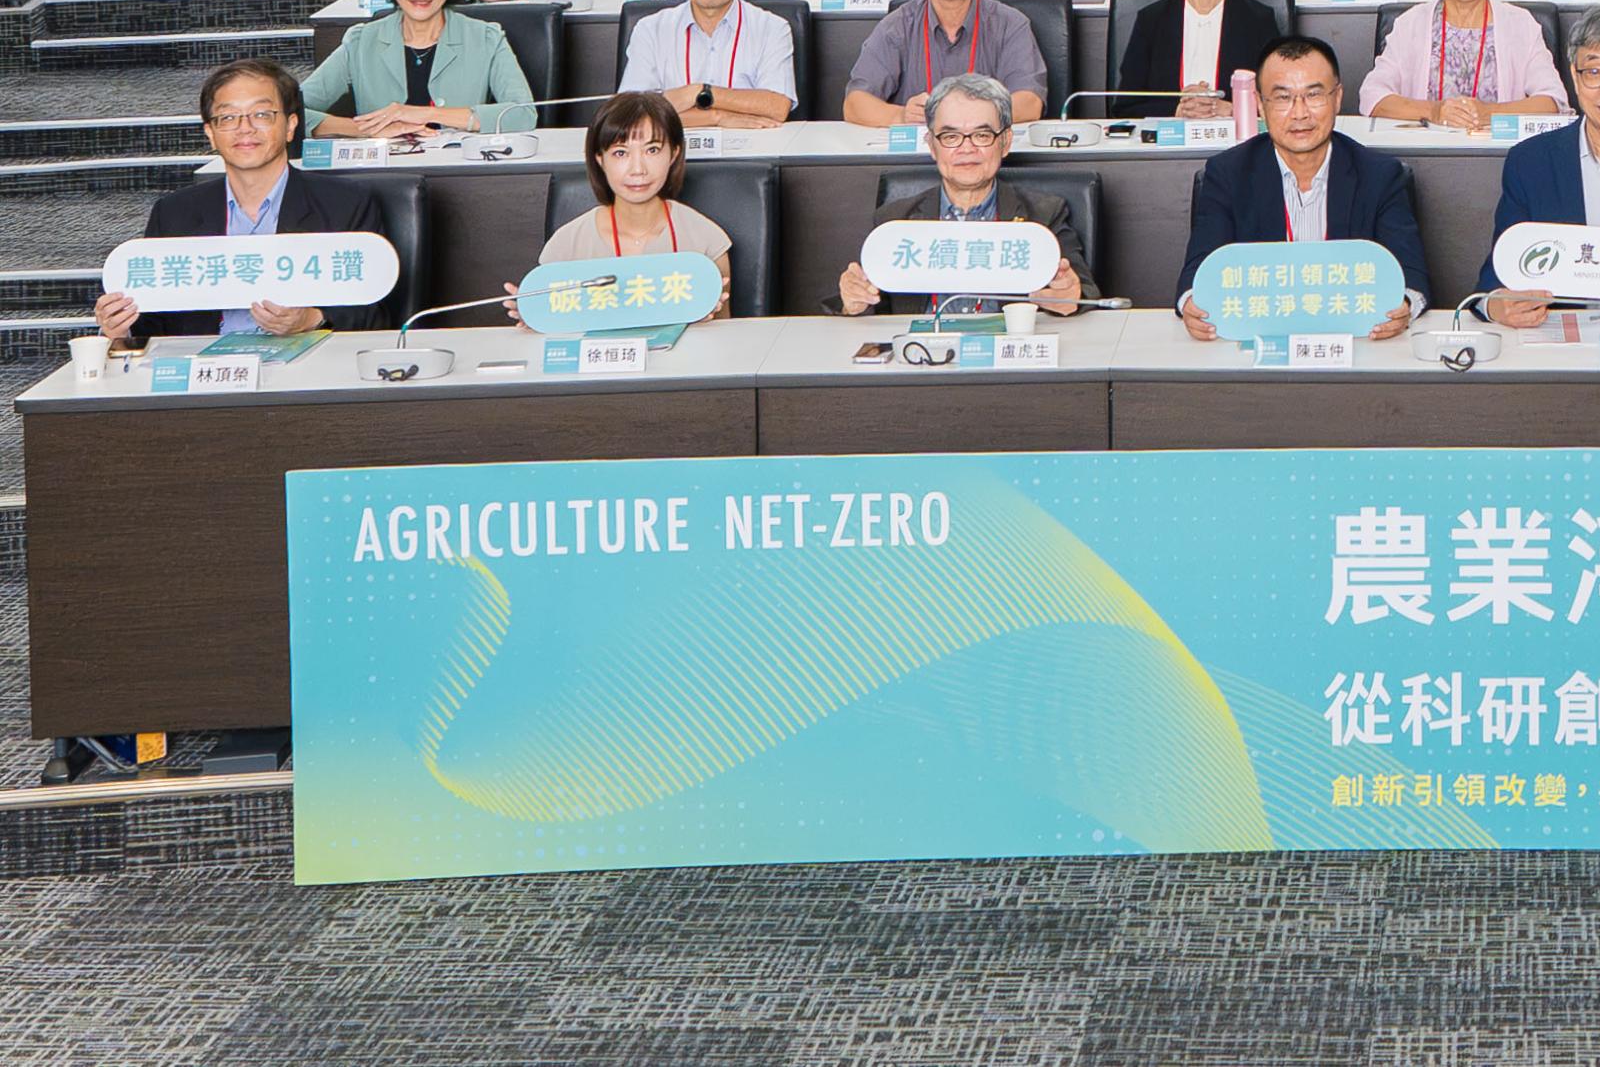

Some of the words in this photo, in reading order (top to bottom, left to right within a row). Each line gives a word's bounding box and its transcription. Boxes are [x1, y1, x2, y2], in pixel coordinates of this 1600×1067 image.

[124, 249, 365, 289] 農業淨零94讚
[892, 238, 1031, 270] 永續實踐
[1220, 261, 1376, 288] 創新引領改變
[549, 271, 693, 313] 碳索未來
[1221, 292, 1377, 319] 共築淨零未來
[1296, 342, 1345, 359] 陳吉仲
[353, 496, 690, 561] AGRICULTURE
[724, 491, 951, 550] NET-ZERO
